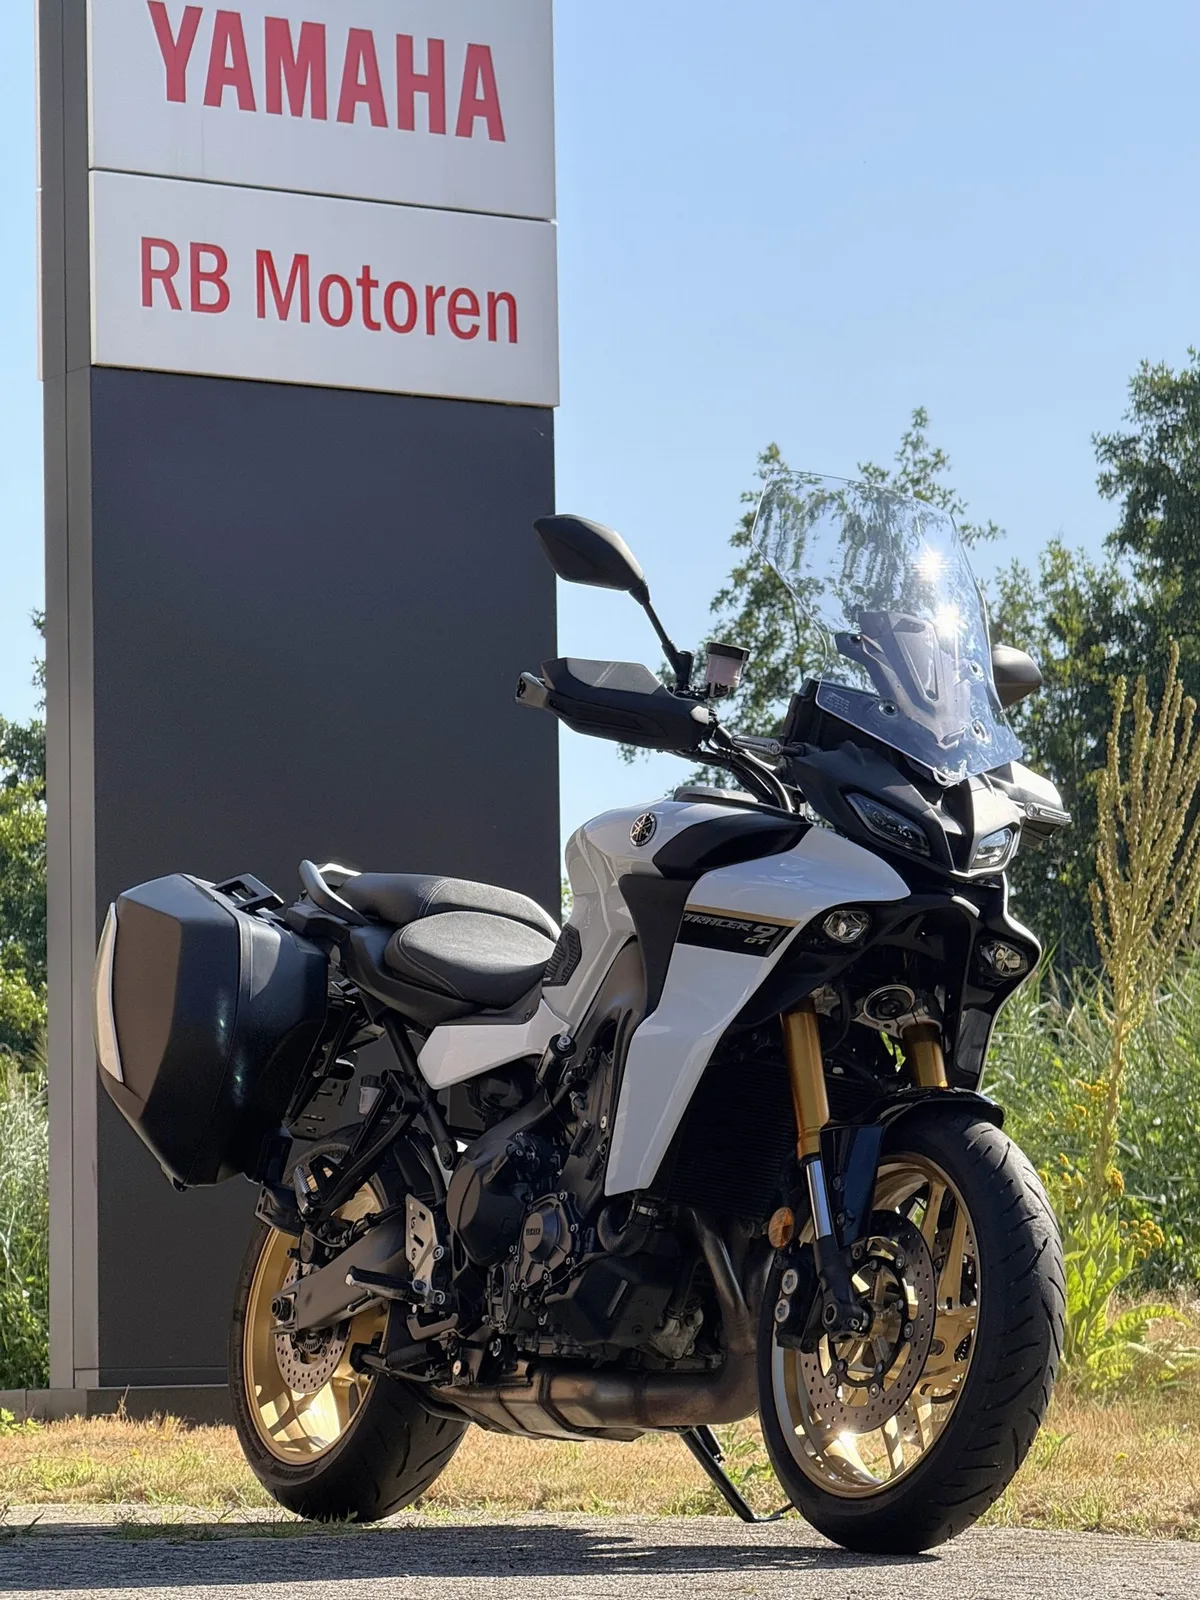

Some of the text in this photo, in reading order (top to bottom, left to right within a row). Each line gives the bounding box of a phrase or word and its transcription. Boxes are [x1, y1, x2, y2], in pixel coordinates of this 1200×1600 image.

[148, 0, 506, 142] YAMAHA
[140, 237, 518, 344] RB Motoren
[683, 913, 779, 938] TRACER 9
[743, 937, 770, 945] GT
